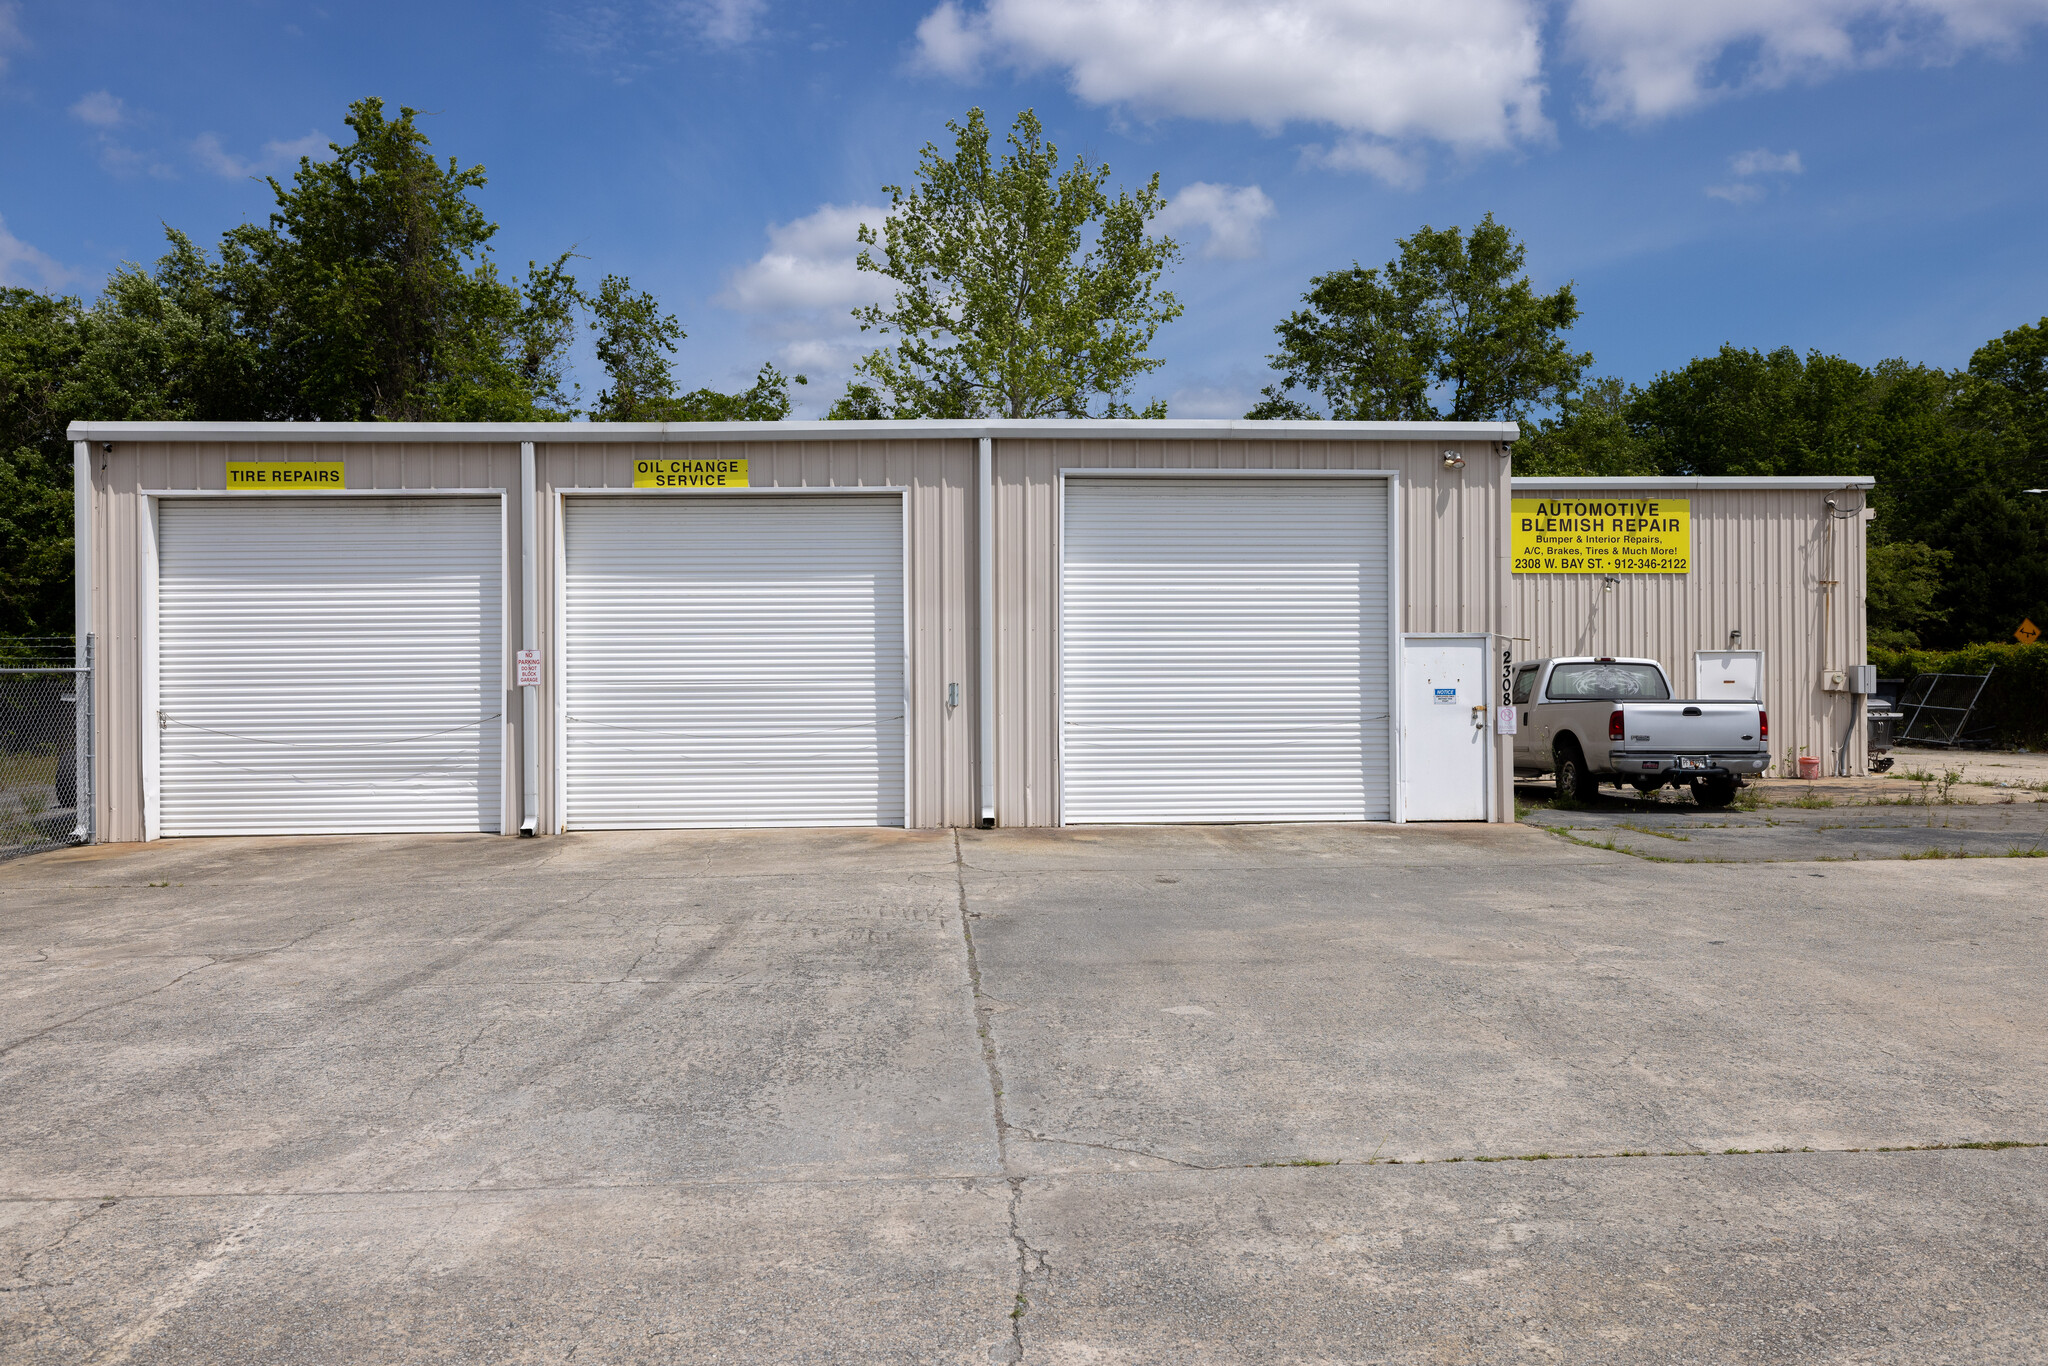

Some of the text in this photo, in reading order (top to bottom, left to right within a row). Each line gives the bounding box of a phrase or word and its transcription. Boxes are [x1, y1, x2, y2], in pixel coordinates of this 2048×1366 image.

[637, 461, 739, 473] OIL CHANGE
[230, 470, 340, 482] TIRE REPAIRS
[656, 474, 726, 486] SERVICE
[1536, 503, 1660, 516] AUTOMOTIVE
[1521, 518, 1680, 532] BLEMISH REPAIR
[1536, 535, 1663, 545] Bumper & Interior Repairs,
[1524, 547, 1678, 556] A/C, Brakes, Tires & Much More!
[1515, 559, 1687, 569] 2308 W. BAY ST. 912-346-2122
[1502, 651, 1511, 705] 2308
